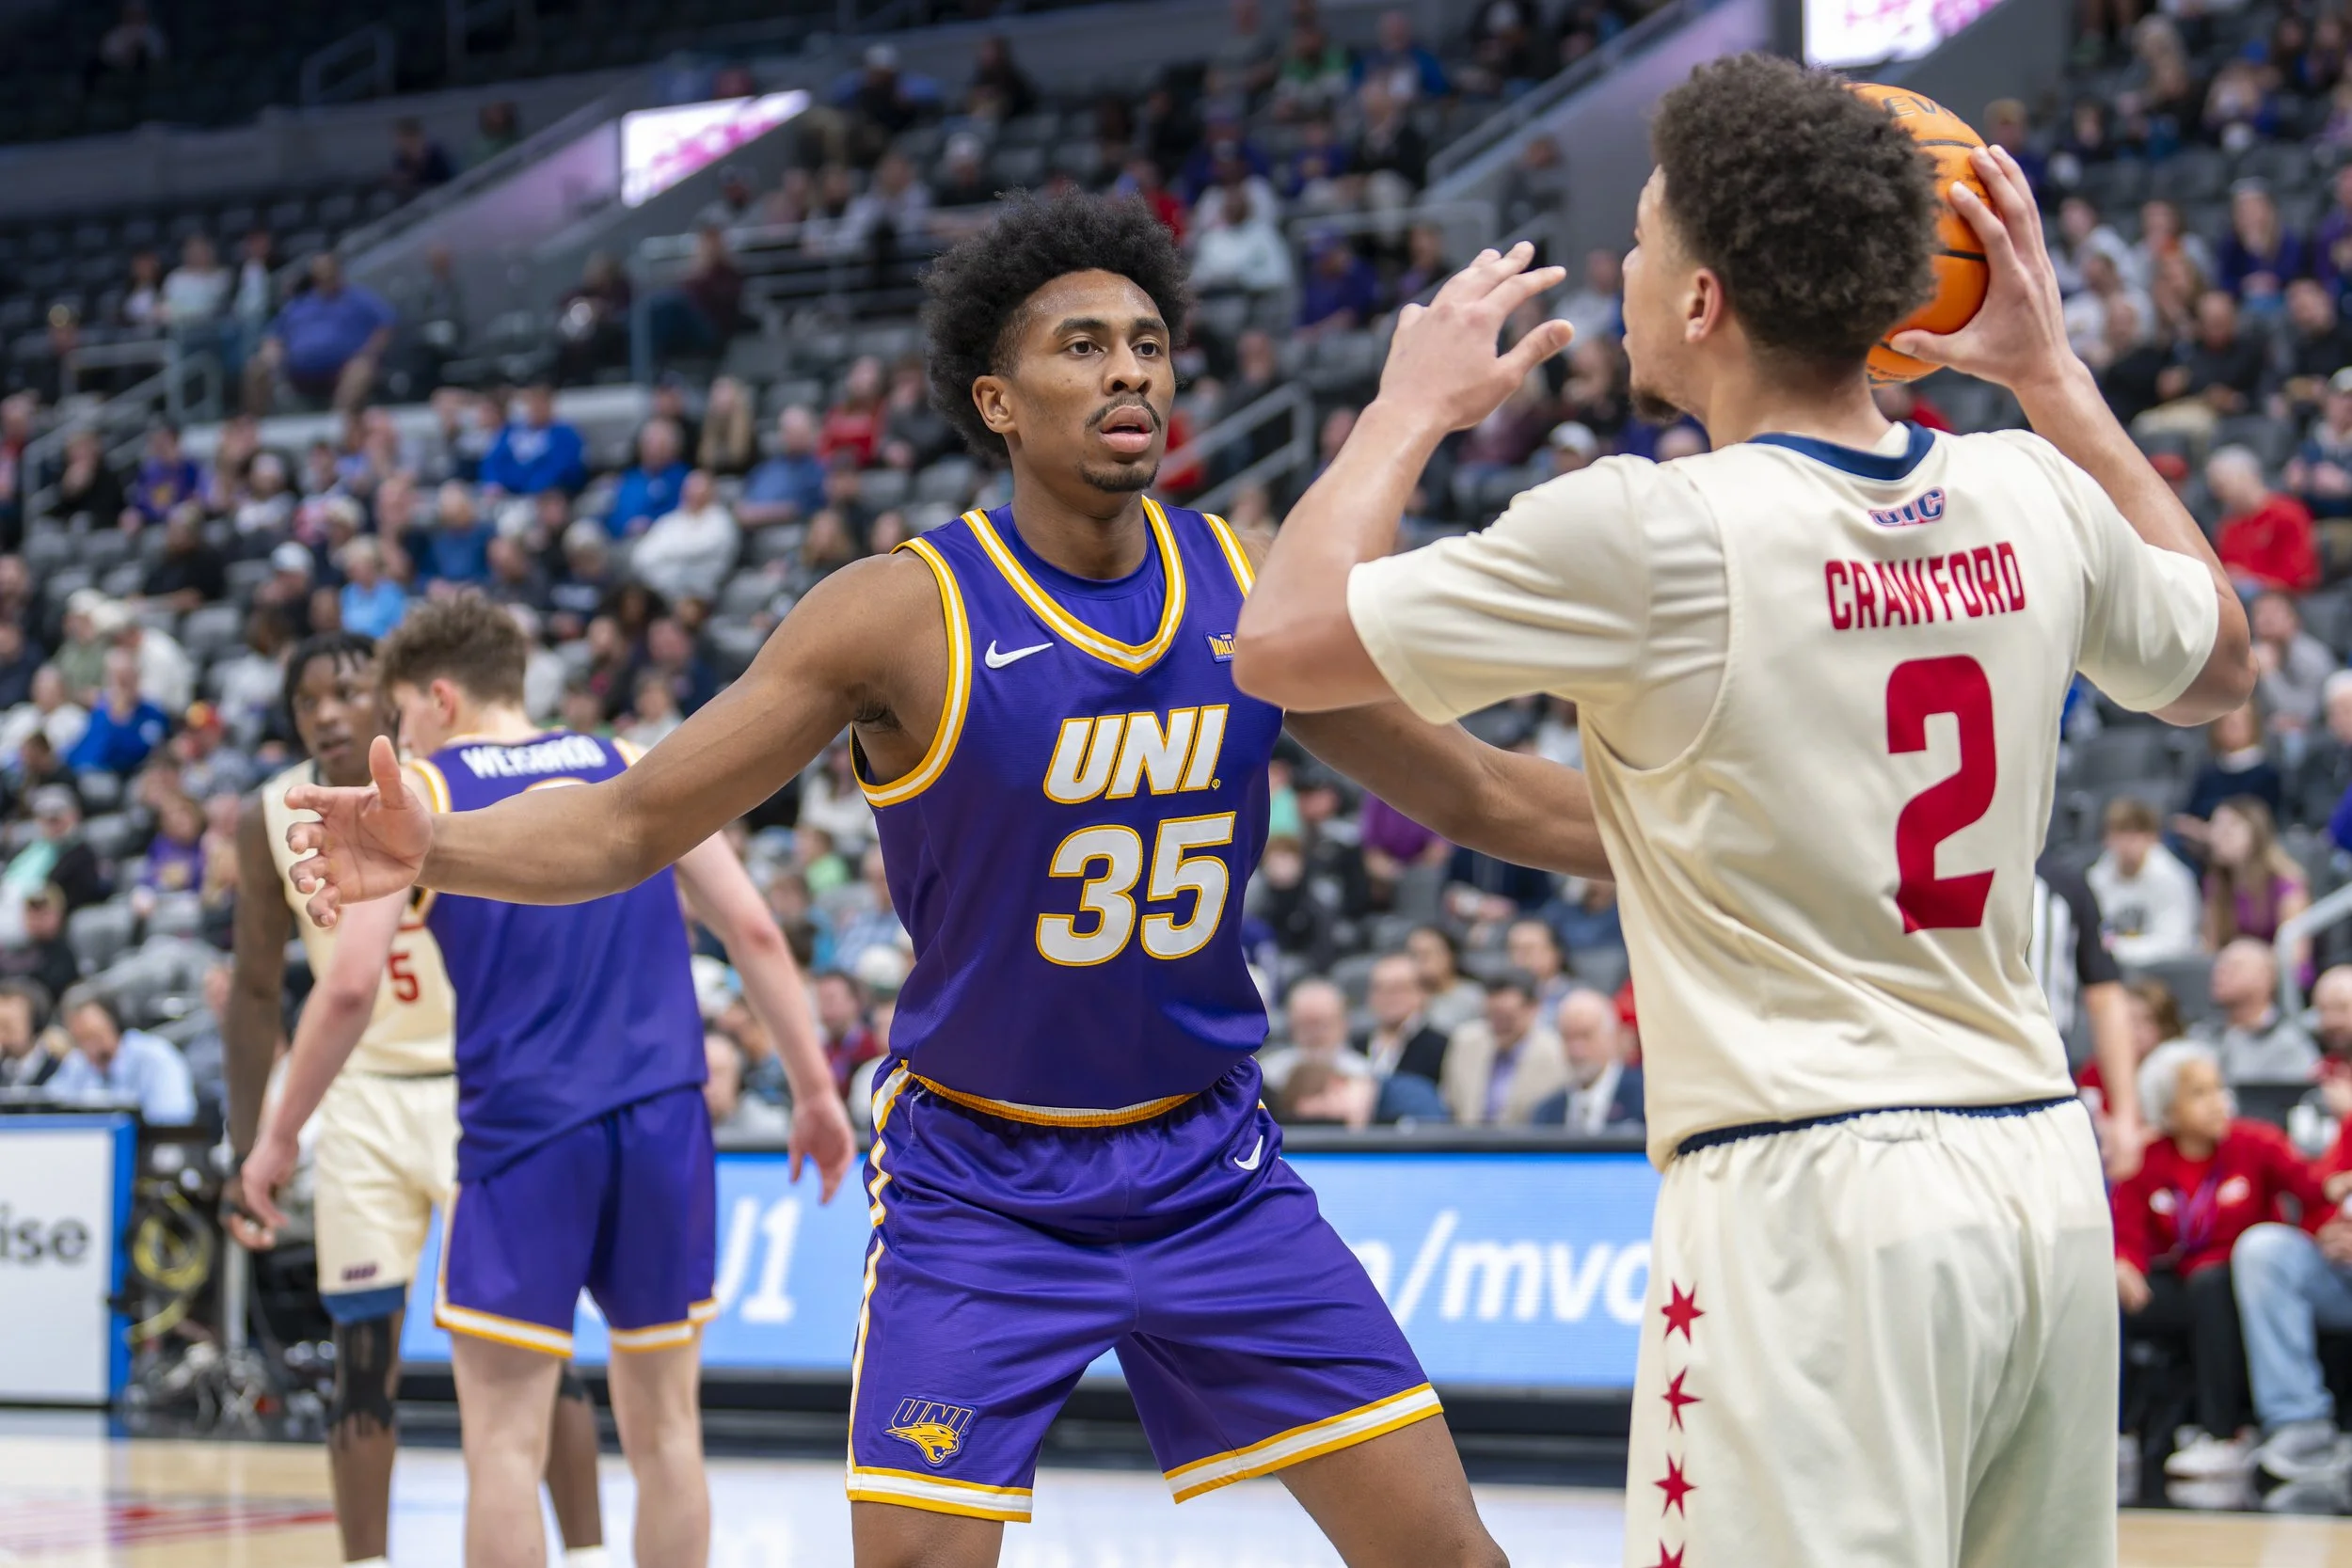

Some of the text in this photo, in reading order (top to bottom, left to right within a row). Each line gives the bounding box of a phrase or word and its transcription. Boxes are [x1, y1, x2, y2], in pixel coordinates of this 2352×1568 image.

[1867, 487, 1945, 527] UIC
[1824, 541, 2026, 630] CRAWFORD
[1043, 704, 1230, 804] UNI
[1886, 654, 1996, 934] 2
[1036, 811, 1237, 966] 35
[891, 1398, 973, 1436] UNI
